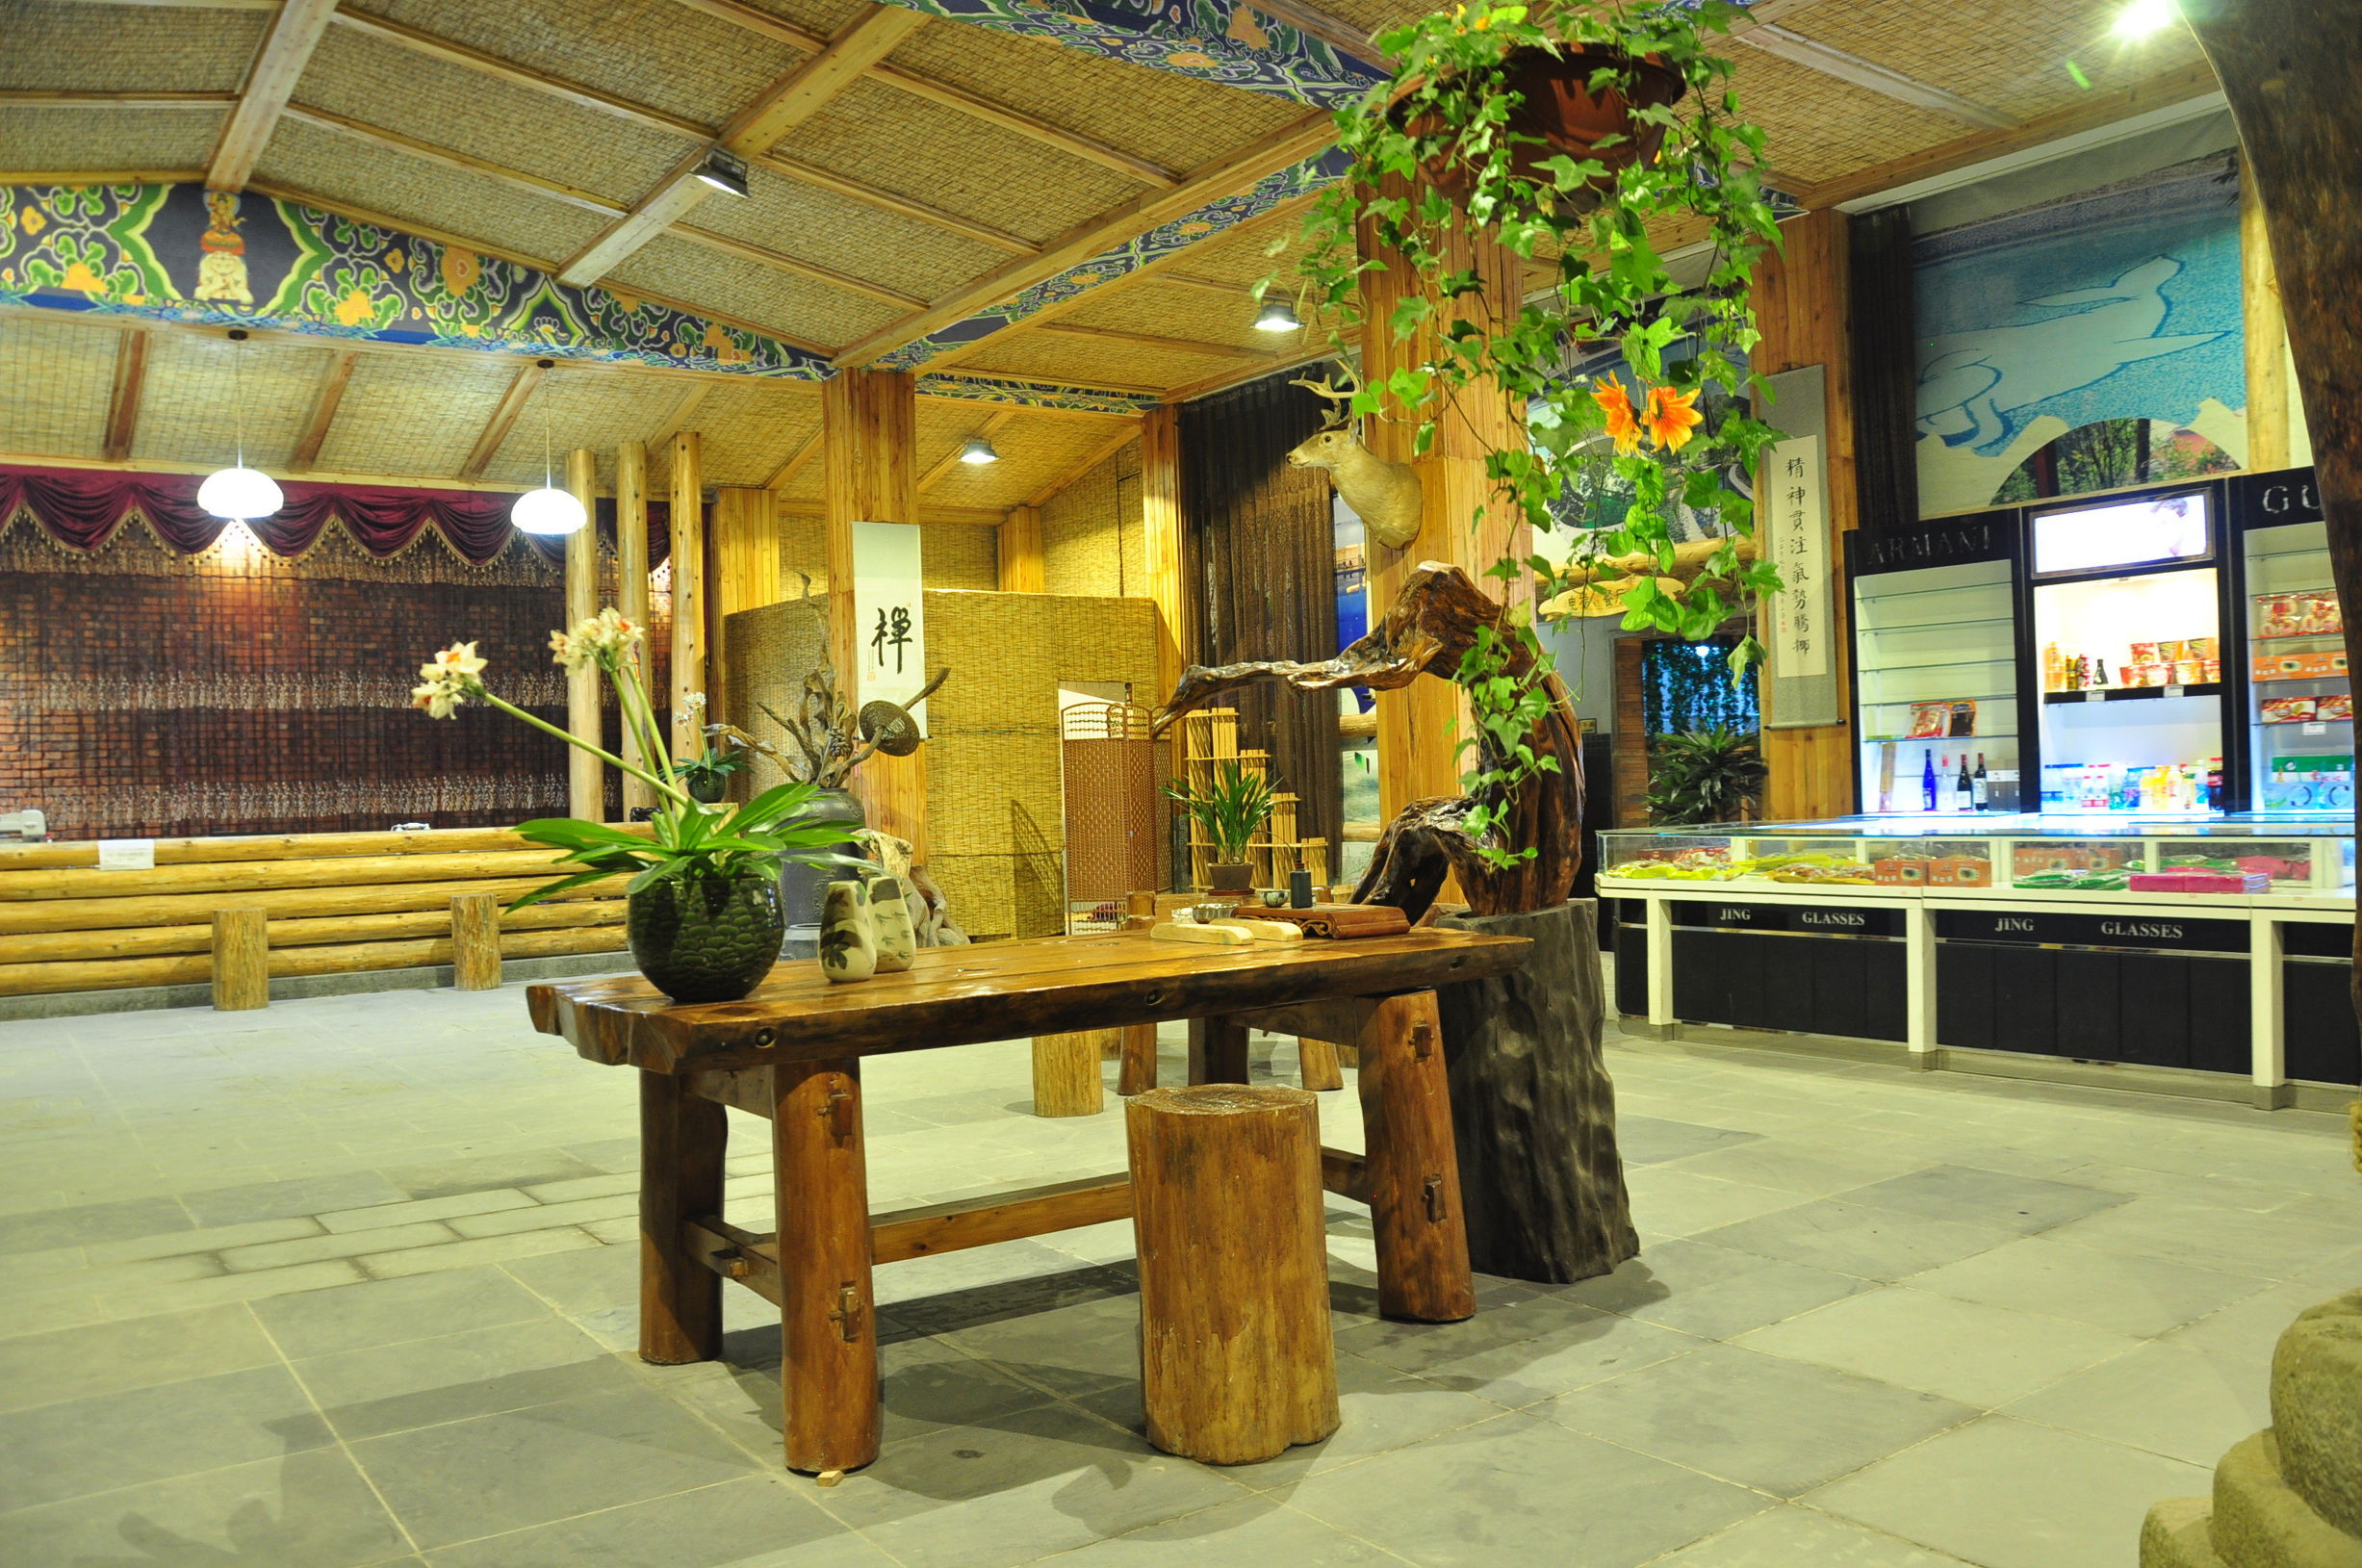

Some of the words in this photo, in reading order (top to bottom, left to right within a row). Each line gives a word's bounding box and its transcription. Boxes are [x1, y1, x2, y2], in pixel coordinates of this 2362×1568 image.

[1720, 908, 1751, 921] JING
[1802, 911, 1865, 926] GLASSES
[1994, 917, 2034, 932] JING
[2100, 921, 2183, 938] GLASSES
